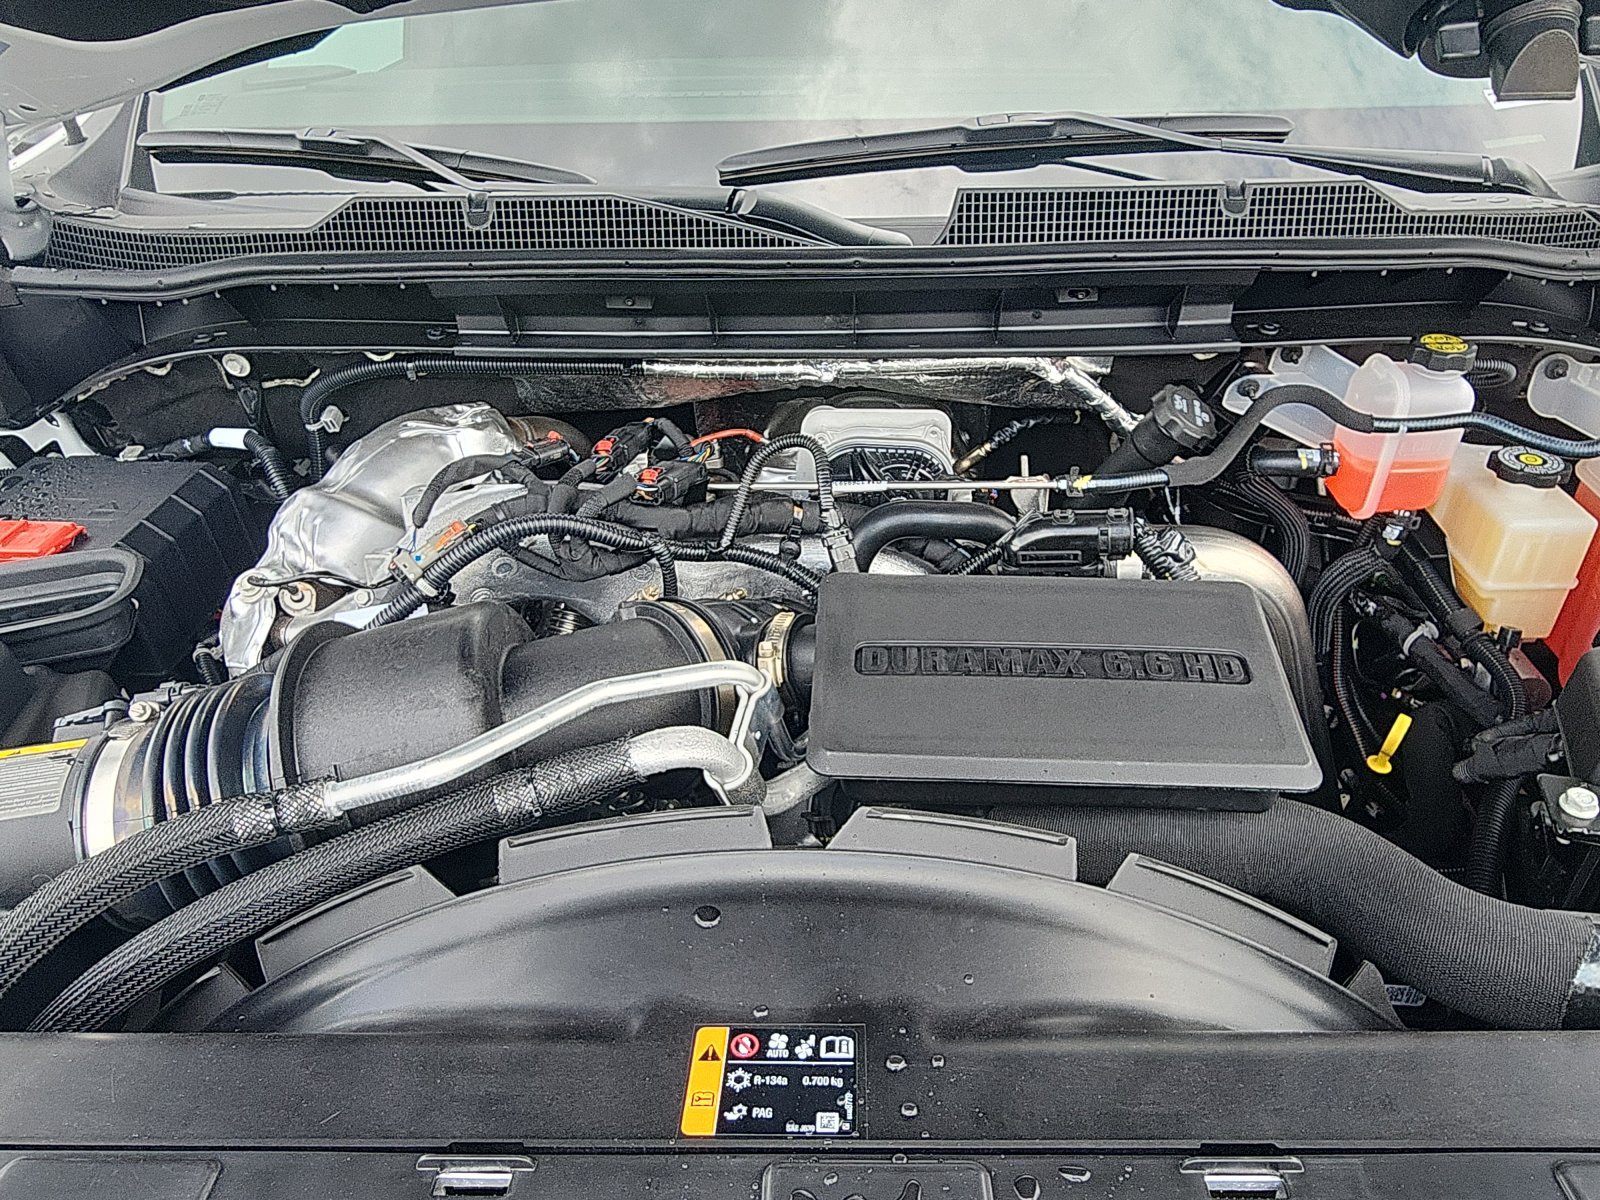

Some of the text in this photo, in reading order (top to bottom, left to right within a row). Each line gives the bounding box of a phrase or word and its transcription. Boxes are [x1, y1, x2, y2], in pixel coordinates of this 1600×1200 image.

[860, 646, 1245, 682] DURAMAX 6.6 HD
[766, 1049, 789, 1058] AUTO
[753, 1075, 844, 1088] R-134a 0.700 kg
[752, 1106, 773, 1118] PAG
